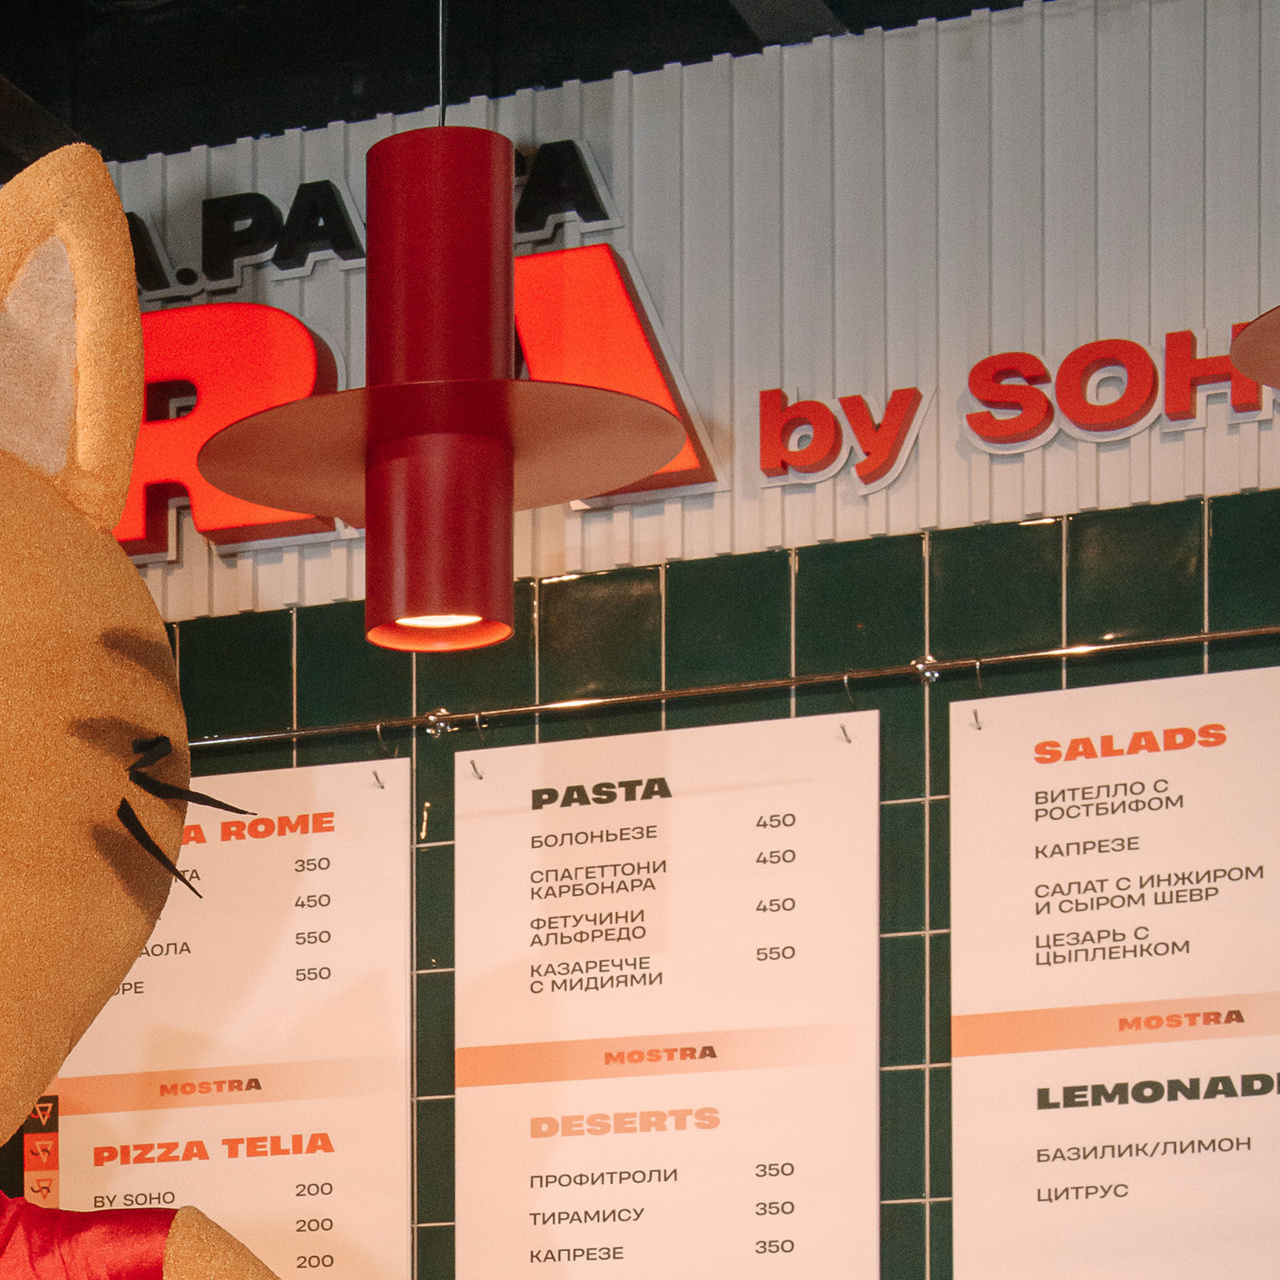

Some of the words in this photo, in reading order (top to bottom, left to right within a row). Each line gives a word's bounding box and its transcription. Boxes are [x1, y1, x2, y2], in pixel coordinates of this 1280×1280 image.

[759, 387, 923, 485] by
[965, 321, 1265, 446] SOH
[1033, 722, 1228, 764] SALADS
[531, 777, 672, 810] PASTA
[1034, 781, 1147, 805] ВИТЕЛЛО
[1153, 778, 1169, 794] С
[1034, 795, 1184, 822] РОСТБИФОМ
[220, 811, 336, 843] ROME
[530, 825, 658, 850] БОЛОНЬЕЗЕ
[755, 812, 797, 830] 450
[1034, 836, 1140, 859] КАПРЕЗЕ
[294, 856, 331, 873] 350
[530, 860, 667, 884] СПАГЕТТОНИ
[755, 848, 797, 866] 450
[530, 877, 656, 901] КАРБОНАРА
[1034, 877, 1109, 899] САЛАТ
[1115, 875, 1132, 892] С
[1138, 864, 1265, 889] ИНЖИРОМ
[294, 893, 331, 909] 450
[530, 909, 645, 932] ФЕТУЧИНИ
[755, 897, 797, 914] 450
[1035, 899, 1053, 916] И
[1058, 891, 1146, 914] СЫРОМ
[1153, 886, 1219, 906] ШЕВР
[138, 942, 192, 959] АОЛА
[295, 930, 332, 946] 550
[530, 925, 647, 948] АЛЬФРЕДО
[1035, 927, 1126, 951] ЦЕЗАРЬ
[1133, 925, 1150, 941] С
[530, 956, 651, 979] КАЗАРЕЧЧЕ
[755, 945, 796, 962] 550
[1035, 940, 1191, 969] ЦЫПЛЕНКОМ
[295, 966, 332, 983] 550
[530, 978, 544, 995] С
[550, 971, 663, 994] МИДИЯМИ
[1119, 1009, 1245, 1031] MOSTRA
[604, 1045, 717, 1065] MOSTRA
[159, 1078, 262, 1098] MOSTRA
[1036, 1072, 1280, 1111] LEMONAD
[530, 1106, 721, 1139] DESERTS
[93, 1139, 210, 1168] PIZZA
[221, 1131, 335, 1161] TELIA
[530, 1168, 679, 1190] ПРОФИТРОЛИ
[754, 1162, 795, 1178] 350
[93, 1192, 118, 1209] BY
[122, 1190, 176, 1206] SOHO
[295, 1182, 333, 1197] 200
[1036, 1183, 1130, 1205] ЦИТРУС
[296, 1218, 333, 1232] 200
[530, 1208, 645, 1226] ТИРАМИСУ
[754, 1200, 795, 1217] 350
[296, 1254, 334, 1269] 200
[530, 1246, 625, 1264] КАПРЕЗЕ
[754, 1239, 795, 1256] 350
